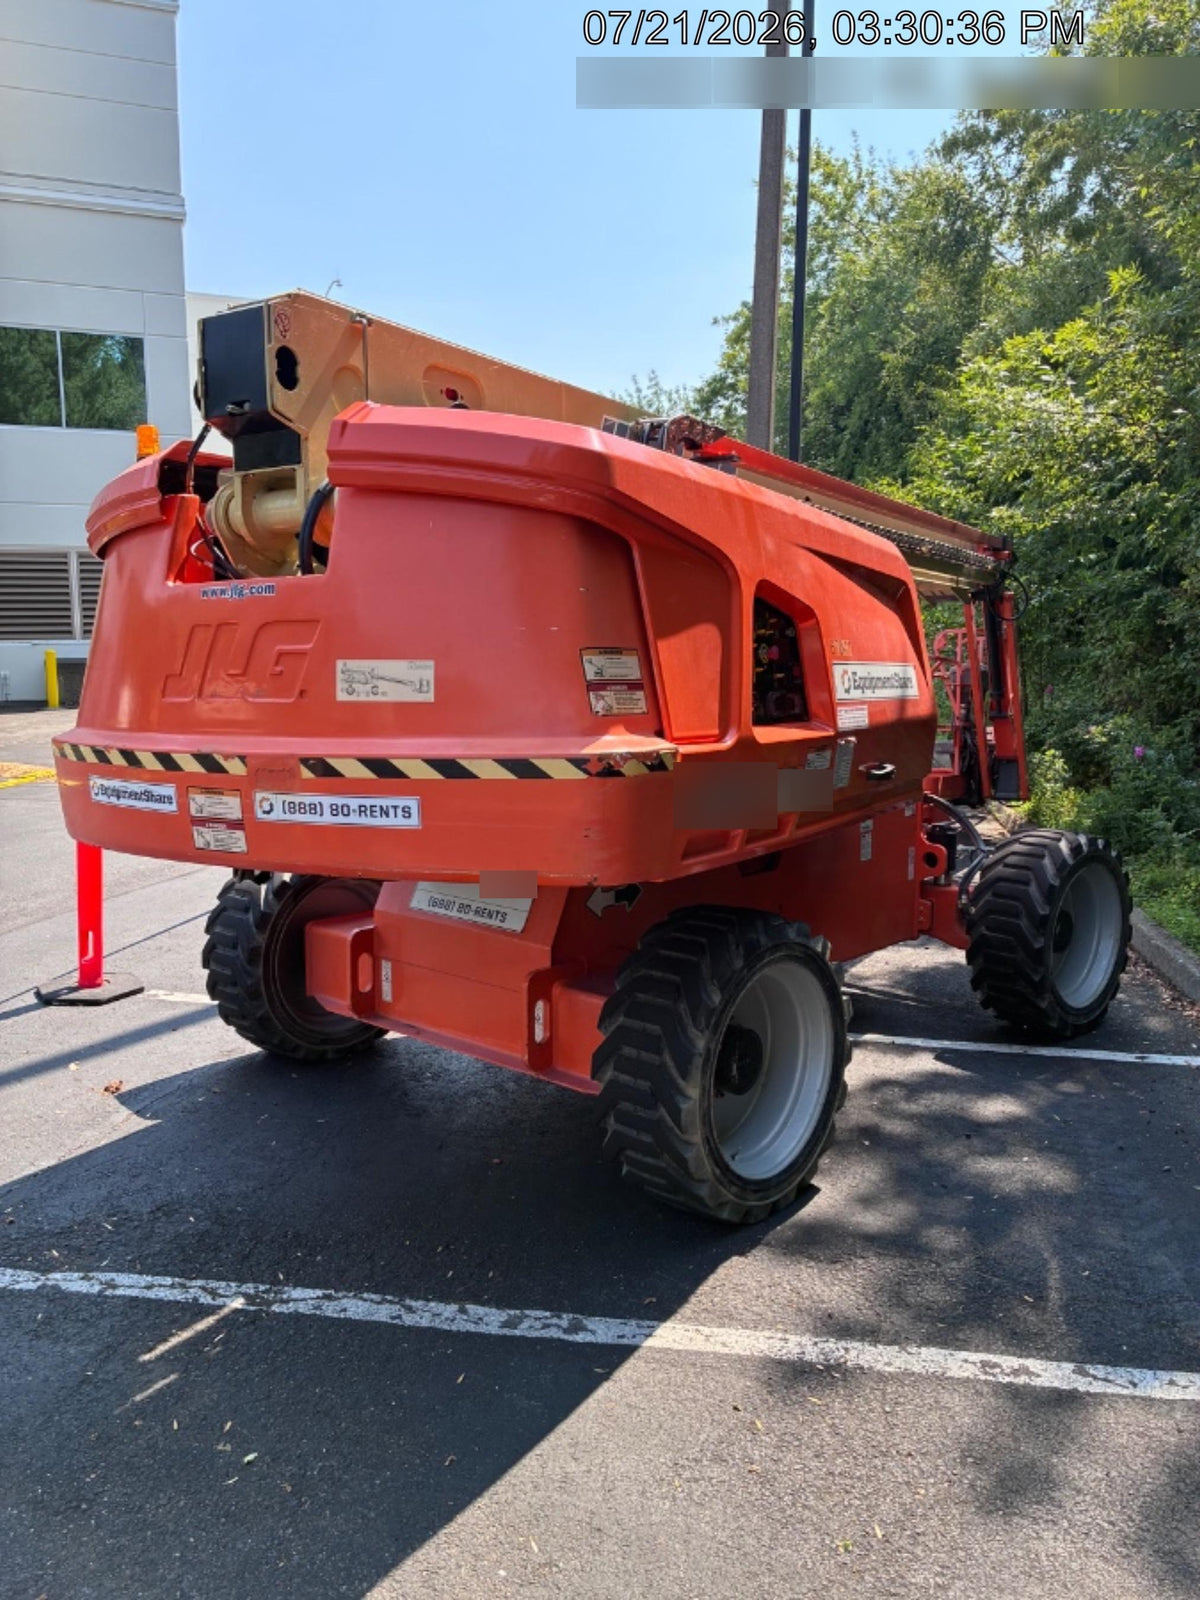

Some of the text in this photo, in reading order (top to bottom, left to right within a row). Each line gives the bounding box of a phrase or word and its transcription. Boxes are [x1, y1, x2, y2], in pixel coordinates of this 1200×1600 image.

[201, 583, 275, 598] www.jlg.com
[161, 619, 322, 703] JLG
[851, 671, 914, 695] EquipmentShare
[100, 783, 174, 805] EquipmentShare
[281, 799, 412, 819] (888) 80-RENTS
